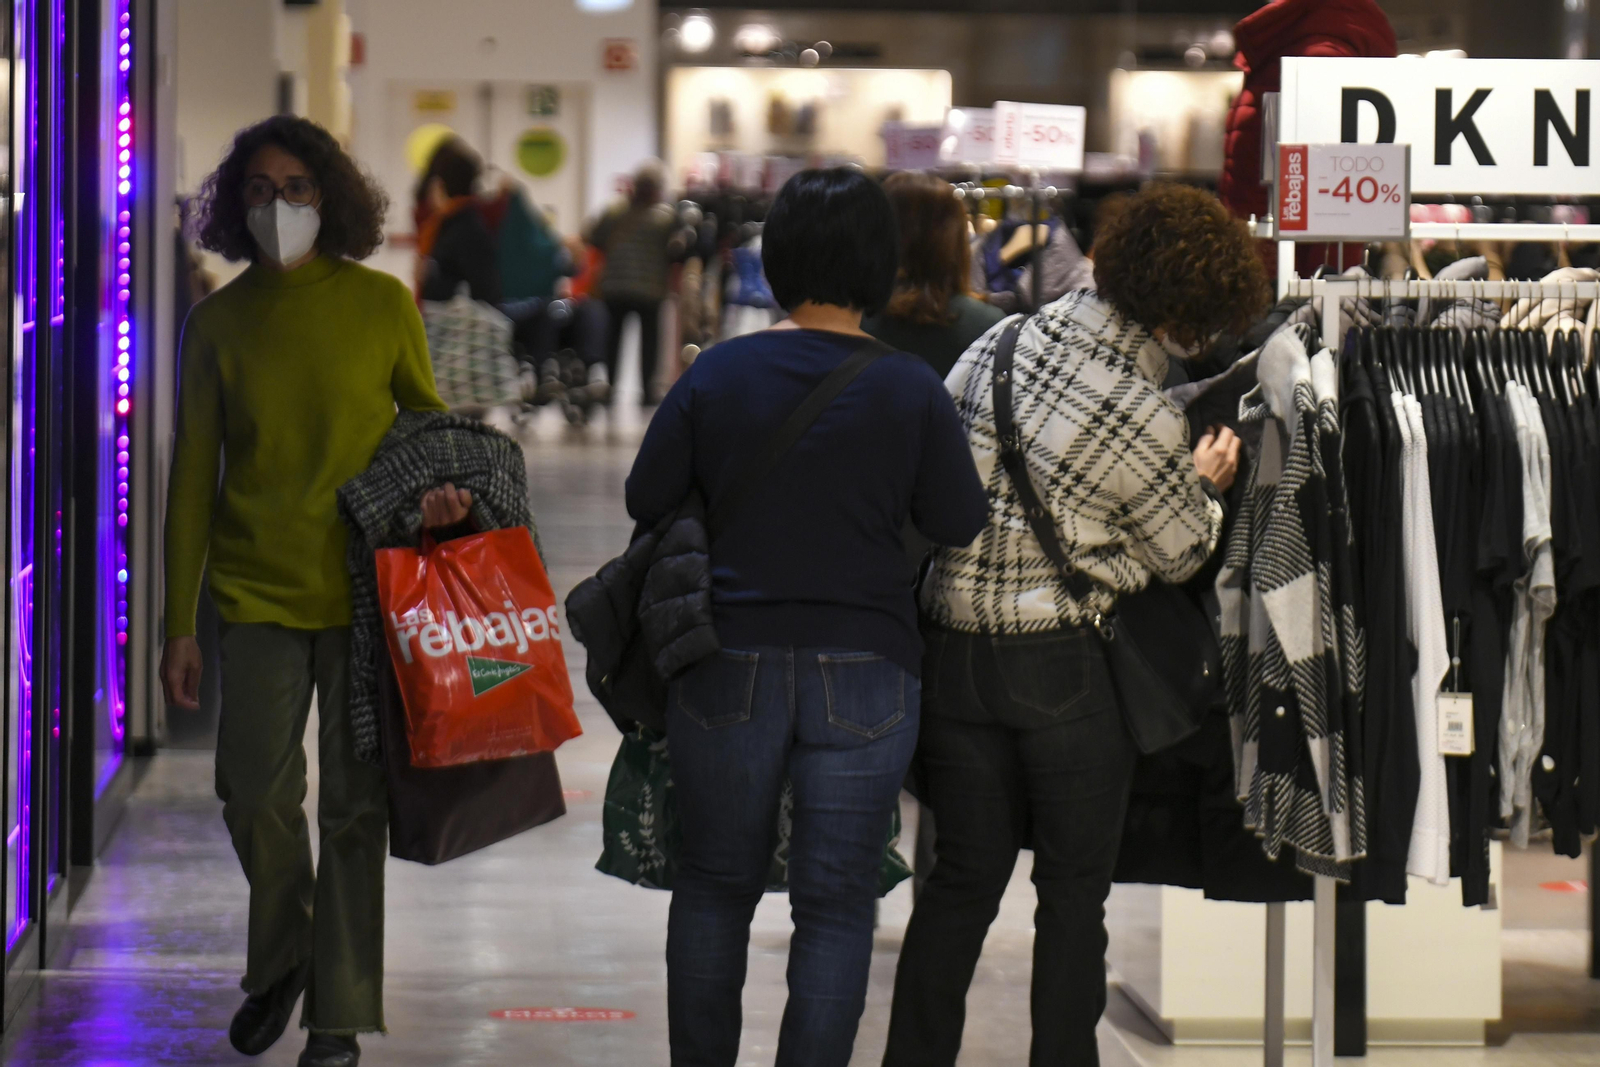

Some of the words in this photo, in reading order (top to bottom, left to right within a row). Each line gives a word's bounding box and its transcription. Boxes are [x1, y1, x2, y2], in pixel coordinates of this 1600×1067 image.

[1330, 156, 1385, 172] TODO
[1285, 152, 1305, 221] rebajas
[1318, 175, 1402, 203] -40%
[390, 607, 436, 630] Las
[396, 600, 562, 664] rebajas
